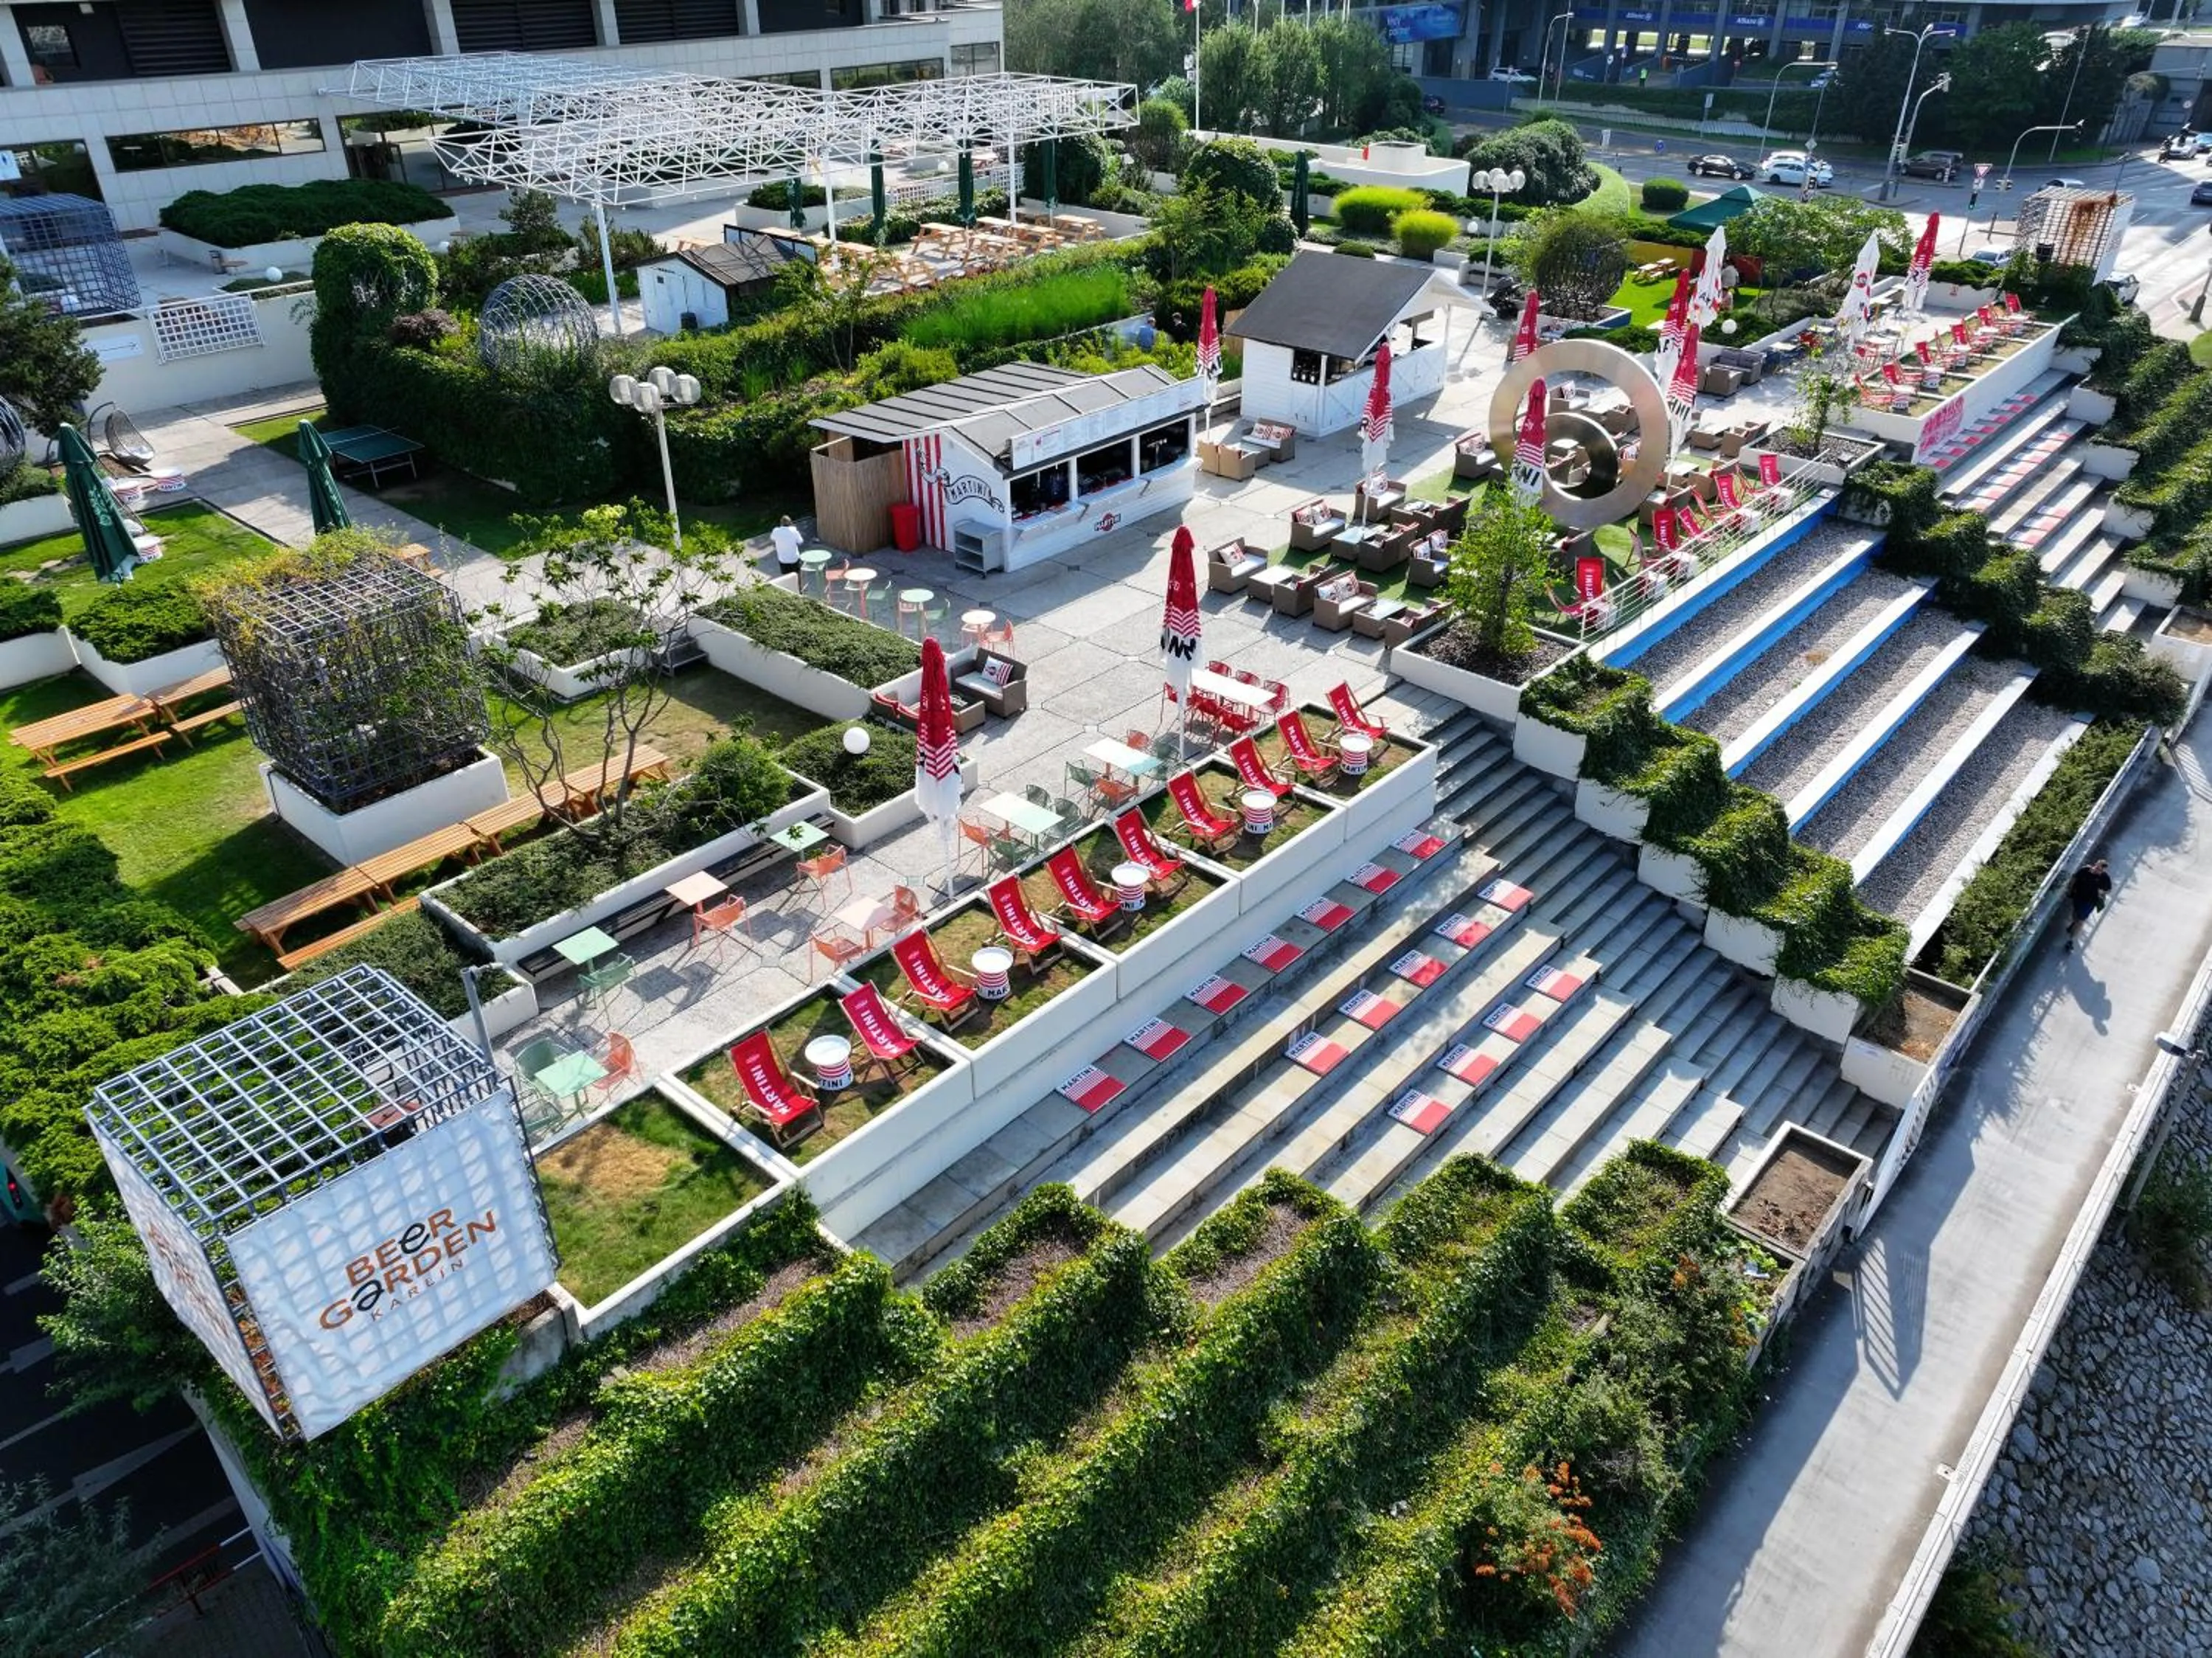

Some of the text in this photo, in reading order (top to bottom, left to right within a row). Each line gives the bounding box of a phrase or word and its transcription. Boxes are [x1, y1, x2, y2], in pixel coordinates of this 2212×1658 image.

[949, 479, 987, 501] MARTINI
[1065, 875, 1103, 915] MARTINI
[1004, 903, 1040, 945] MARTINI
[913, 960, 953, 1003] MARTINI
[860, 1010, 902, 1054] MARTINI
[1130, 1019, 1162, 1041] MARTINI
[1291, 1034, 1318, 1055] MARTINI
[750, 1064, 791, 1114] MARTINI
[1061, 1066, 1095, 1091] MARTINI
[1393, 1092, 1419, 1116] MARTINI
